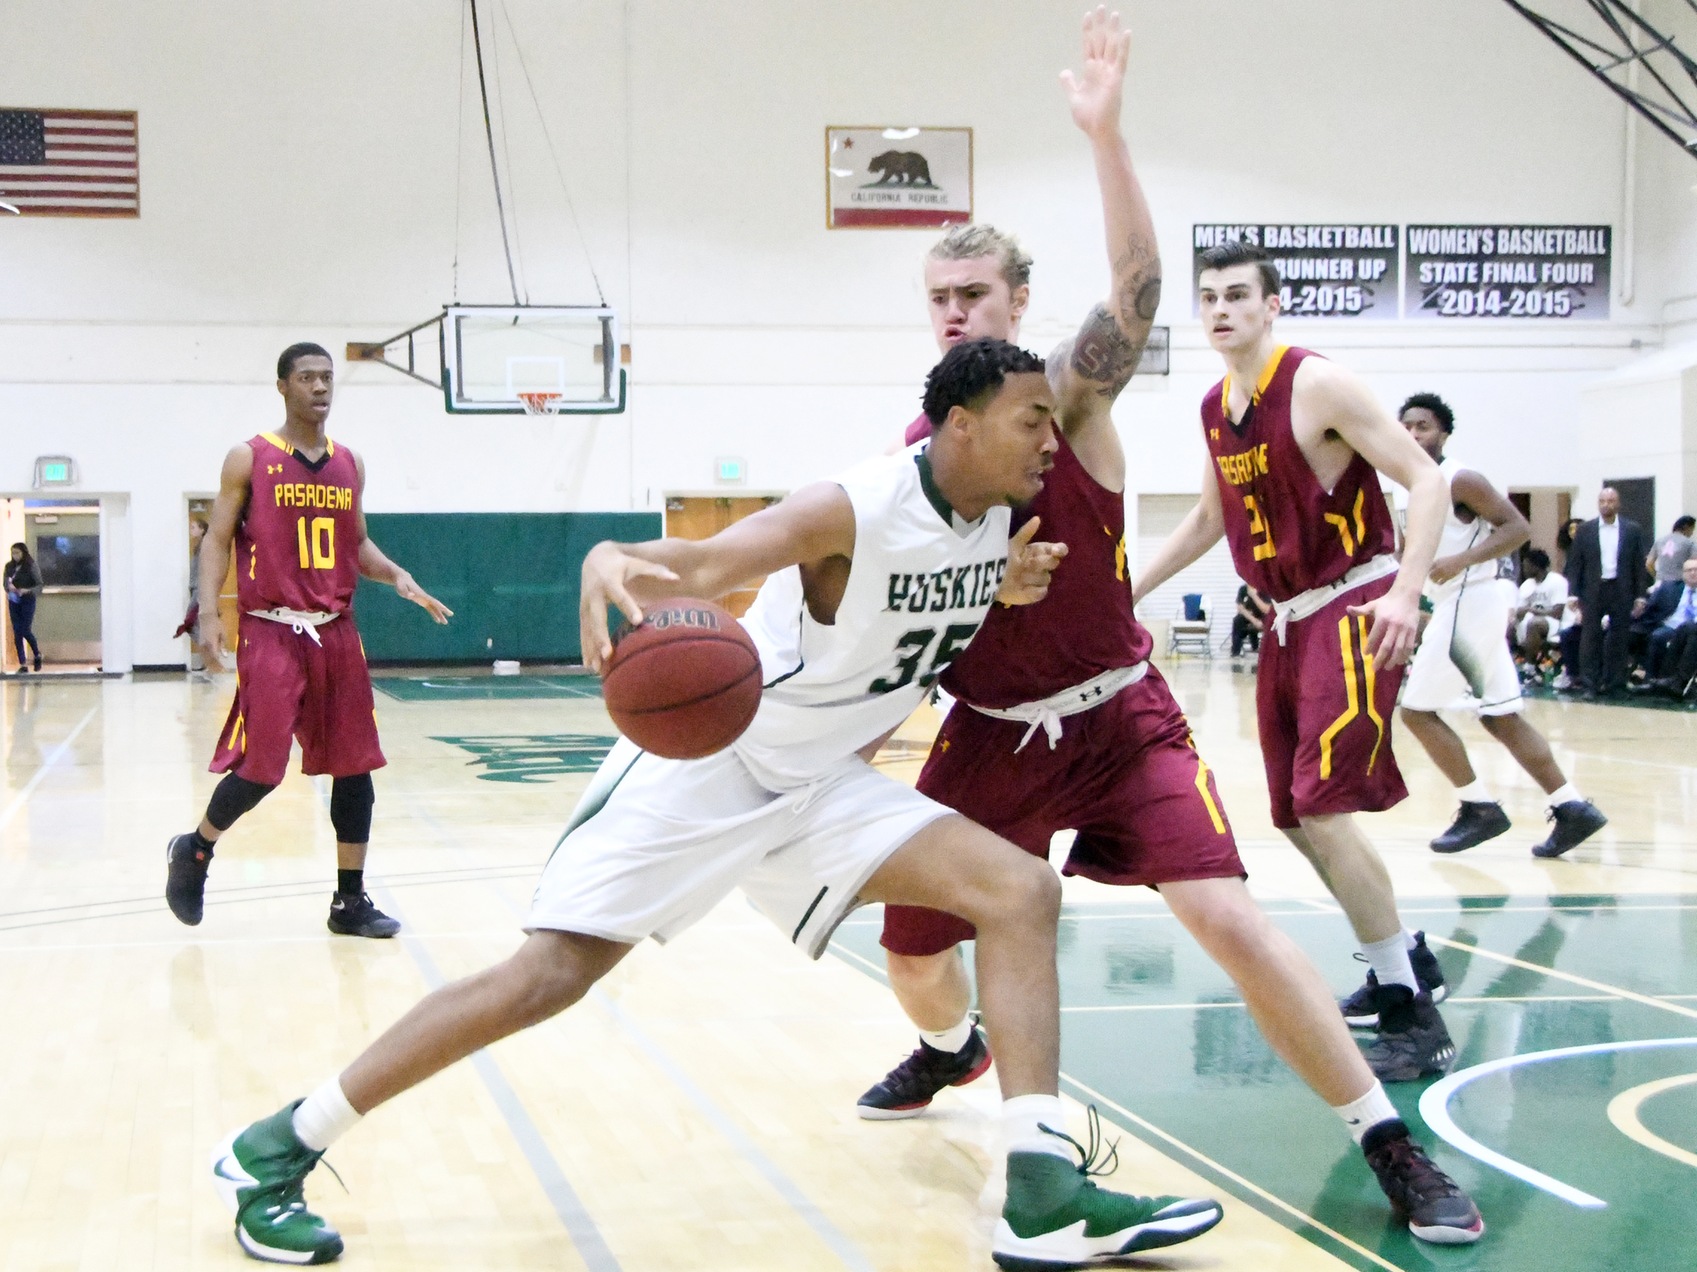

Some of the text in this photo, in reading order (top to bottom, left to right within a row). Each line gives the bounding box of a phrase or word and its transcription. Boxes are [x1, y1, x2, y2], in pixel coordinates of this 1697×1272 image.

[850, 192, 949, 205] CALIFORNIA REPUBLIC
[1194, 226, 1396, 249] MEN'S BASKETBALL
[1409, 228, 1607, 255] WOMEN'S BASKETBALL
[1358, 258, 1387, 280] UP
[1419, 261, 1595, 284] STATE FINAL FOUR
[1279, 285, 1363, 312] 4-2015
[1440, 288, 1572, 316] 2014-2015
[274, 482, 353, 511] PASADENA
[297, 516, 336, 570] 10
[868, 622, 980, 695] 35
